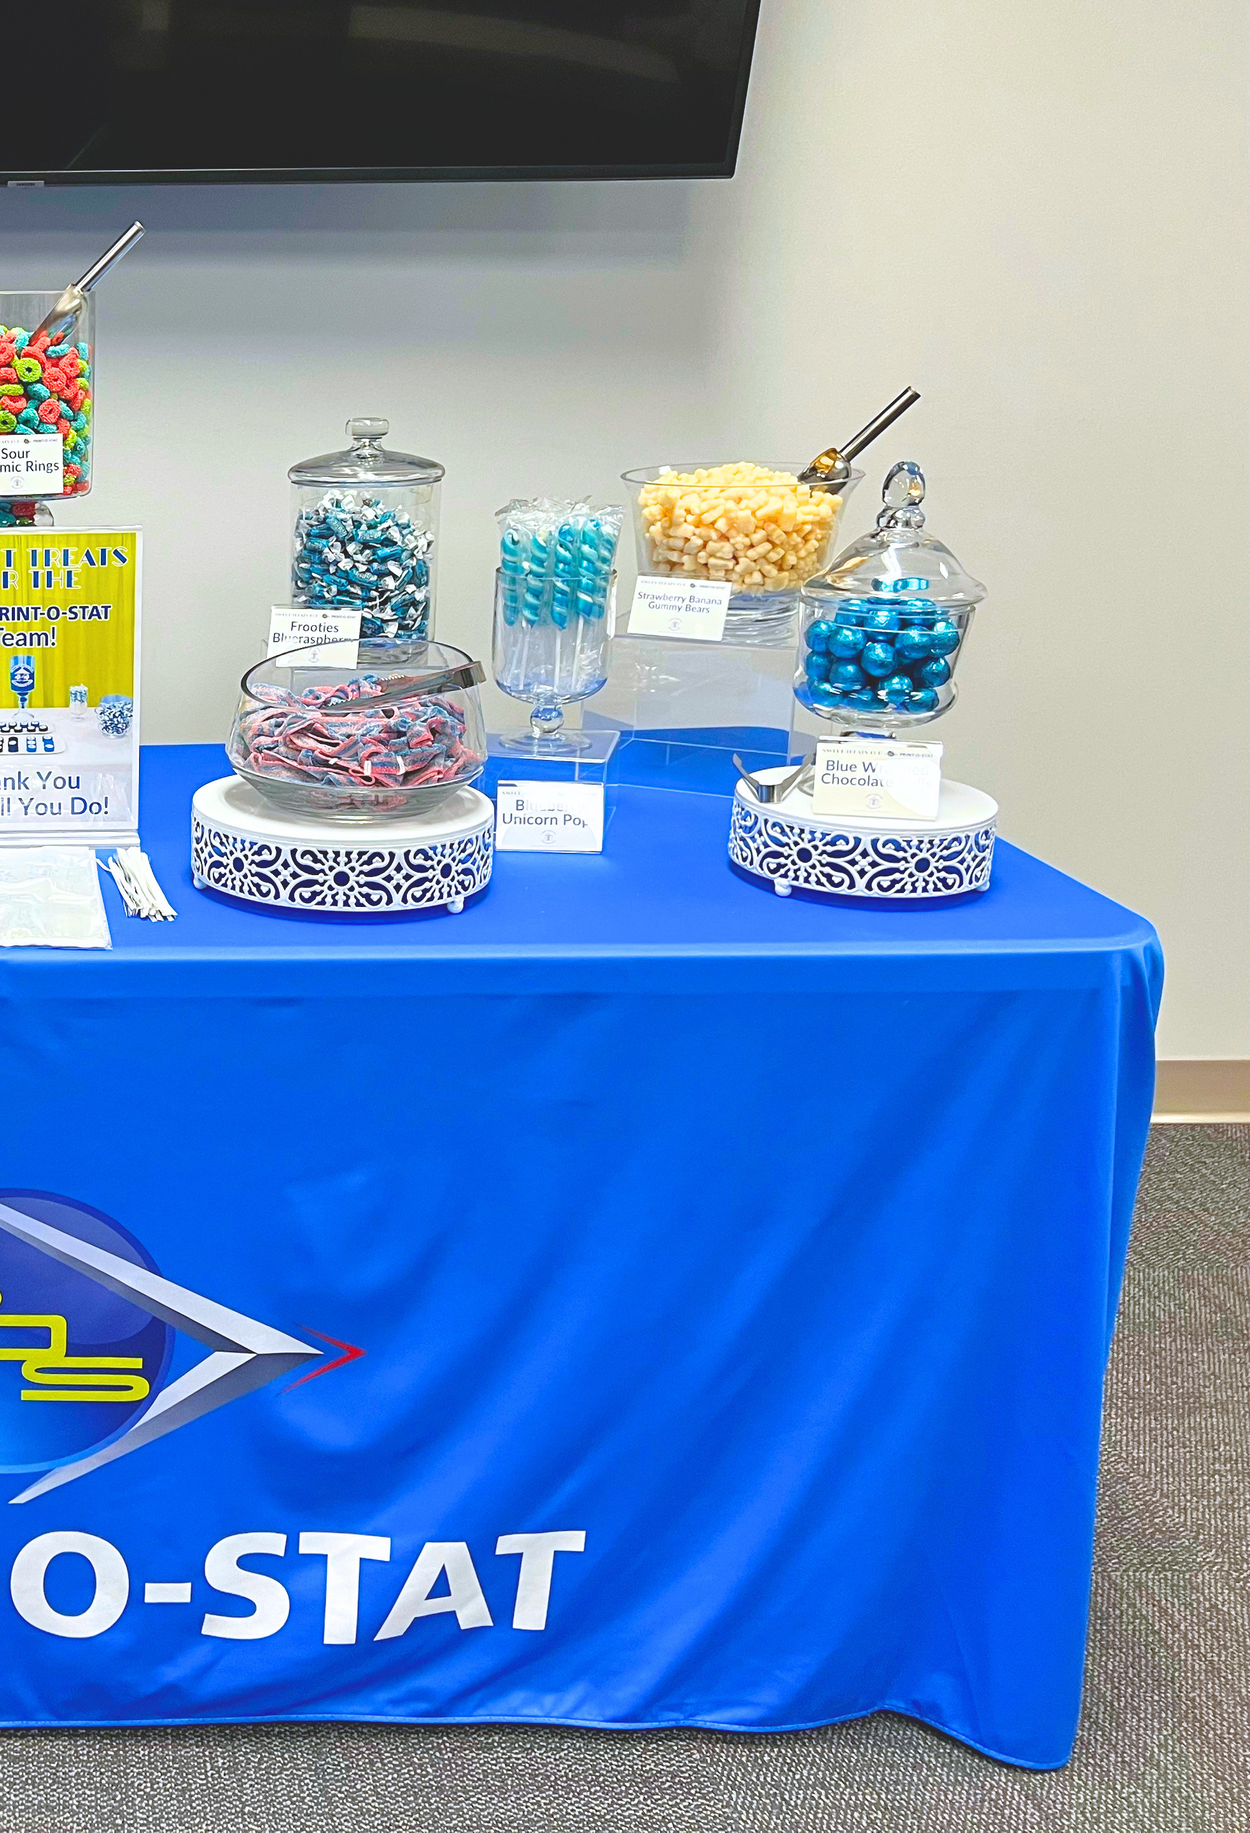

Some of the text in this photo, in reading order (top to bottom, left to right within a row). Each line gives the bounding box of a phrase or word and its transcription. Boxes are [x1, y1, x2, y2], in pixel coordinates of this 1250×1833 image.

[1, 447, 30, 460] Sour
[26, 460, 60, 474] Rings
[27, 546, 128, 568] TREATS
[29, 569, 81, 589] THE
[638, 592, 722, 605] Strawberry Banana
[648, 601, 710, 614] Gummy Bears
[290, 621, 339, 633] Frooties
[272, 632, 354, 645] Blueraspber
[826, 760, 858, 772] Blue
[36, 770, 80, 790] You
[18, 797, 62, 816] You
[70, 796, 109, 816] Do!
[502, 813, 558, 826] Unicorn
